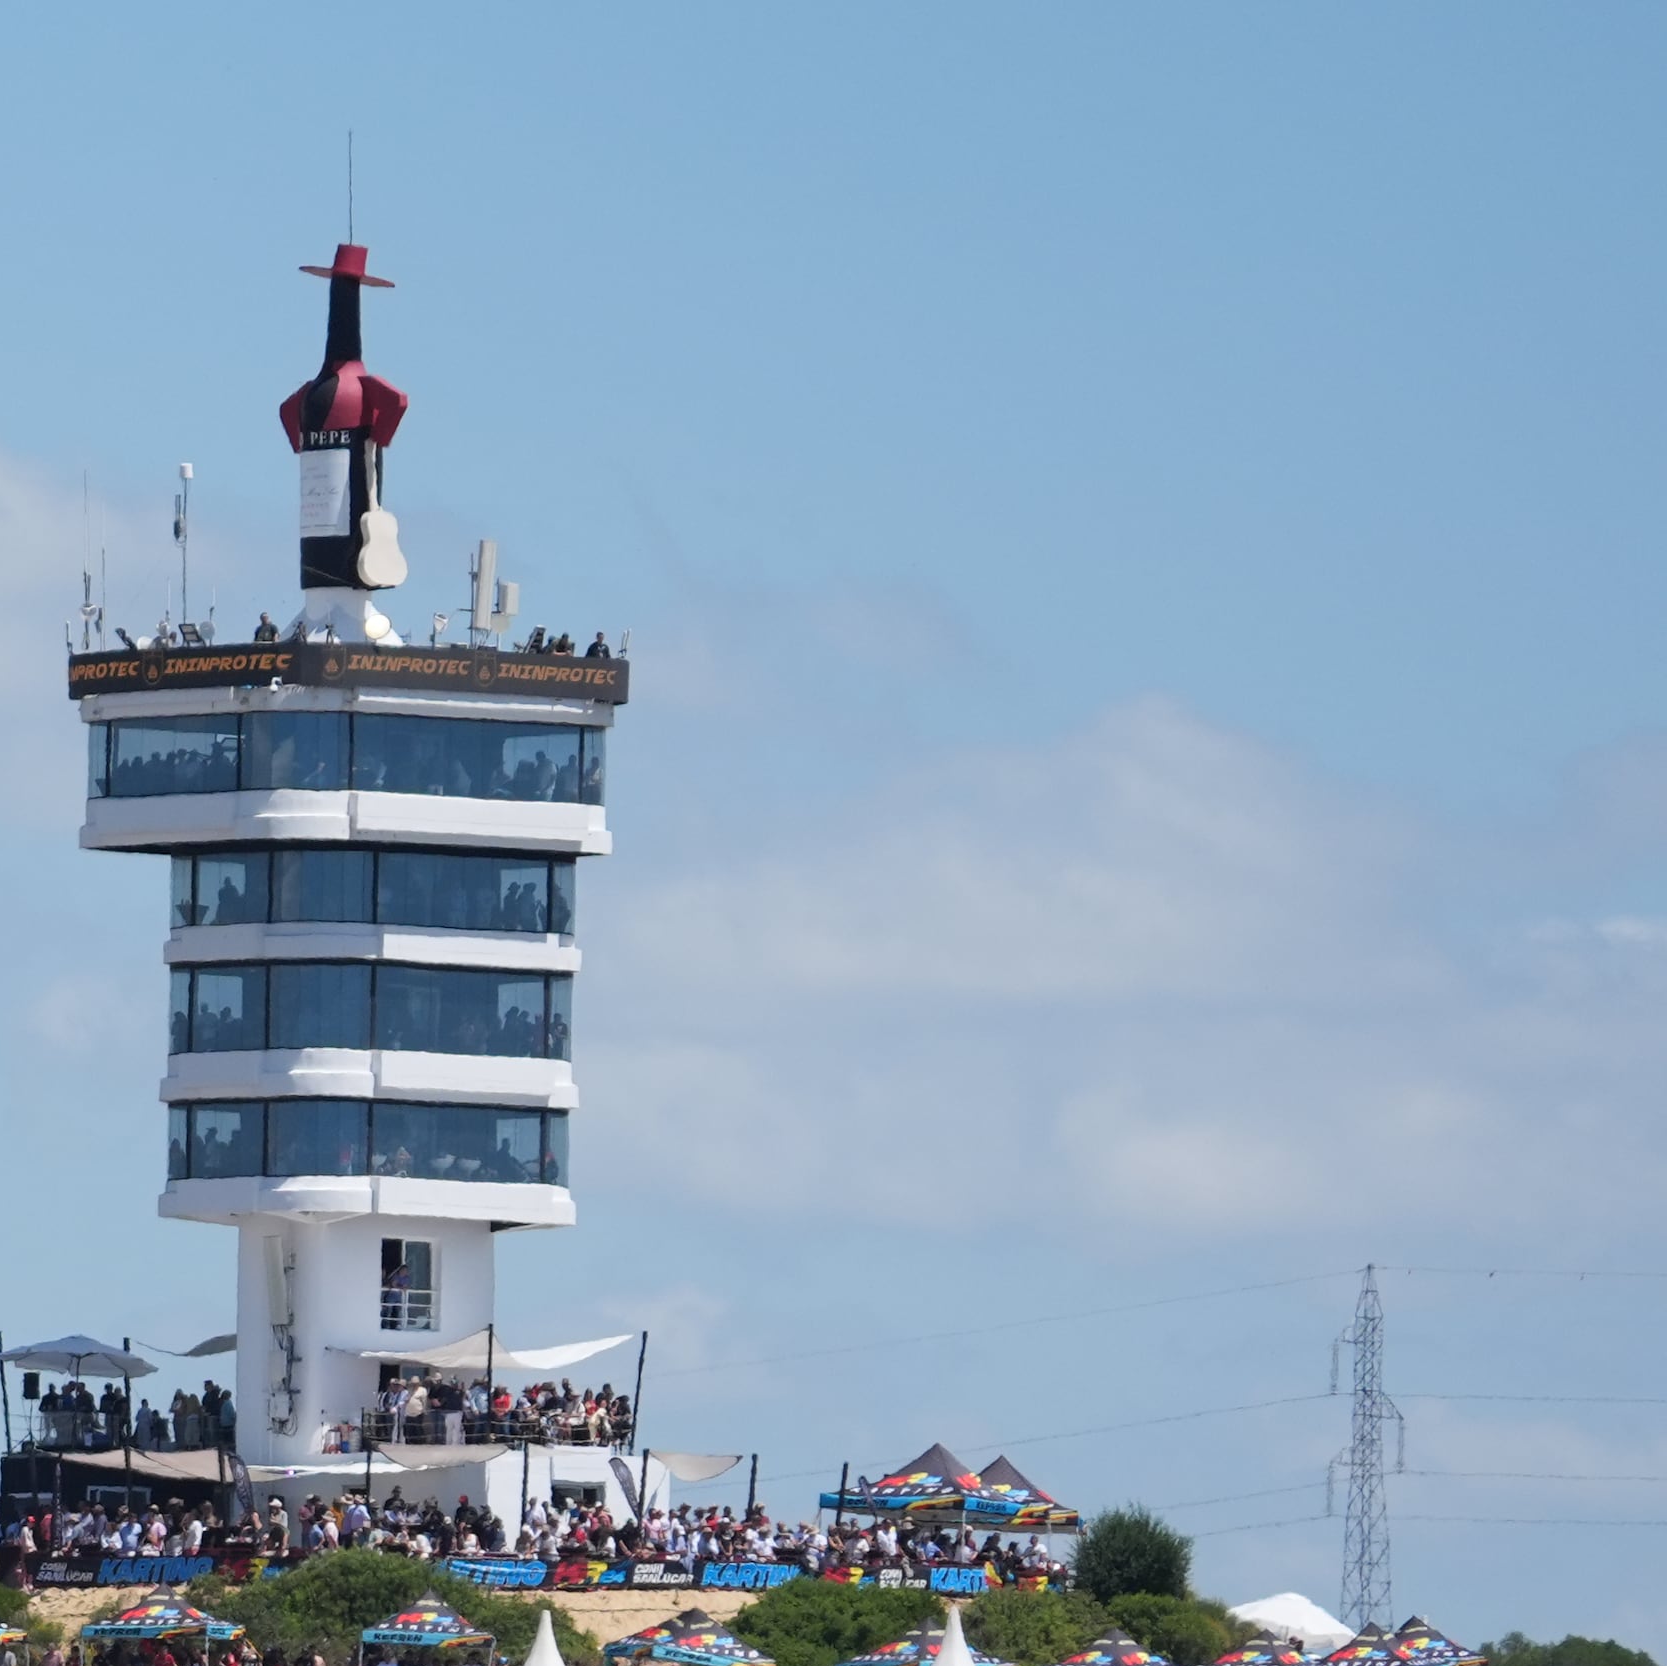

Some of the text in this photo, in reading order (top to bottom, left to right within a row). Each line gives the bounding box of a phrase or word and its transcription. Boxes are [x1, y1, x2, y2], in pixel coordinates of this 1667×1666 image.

[310, 430, 351, 445] PEPE
[164, 653, 294, 673] ININPROTEC
[347, 654, 472, 676] ININPROTEC
[497, 662, 628, 685] ININPROTEC
[97, 1557, 214, 1584] KARTING
